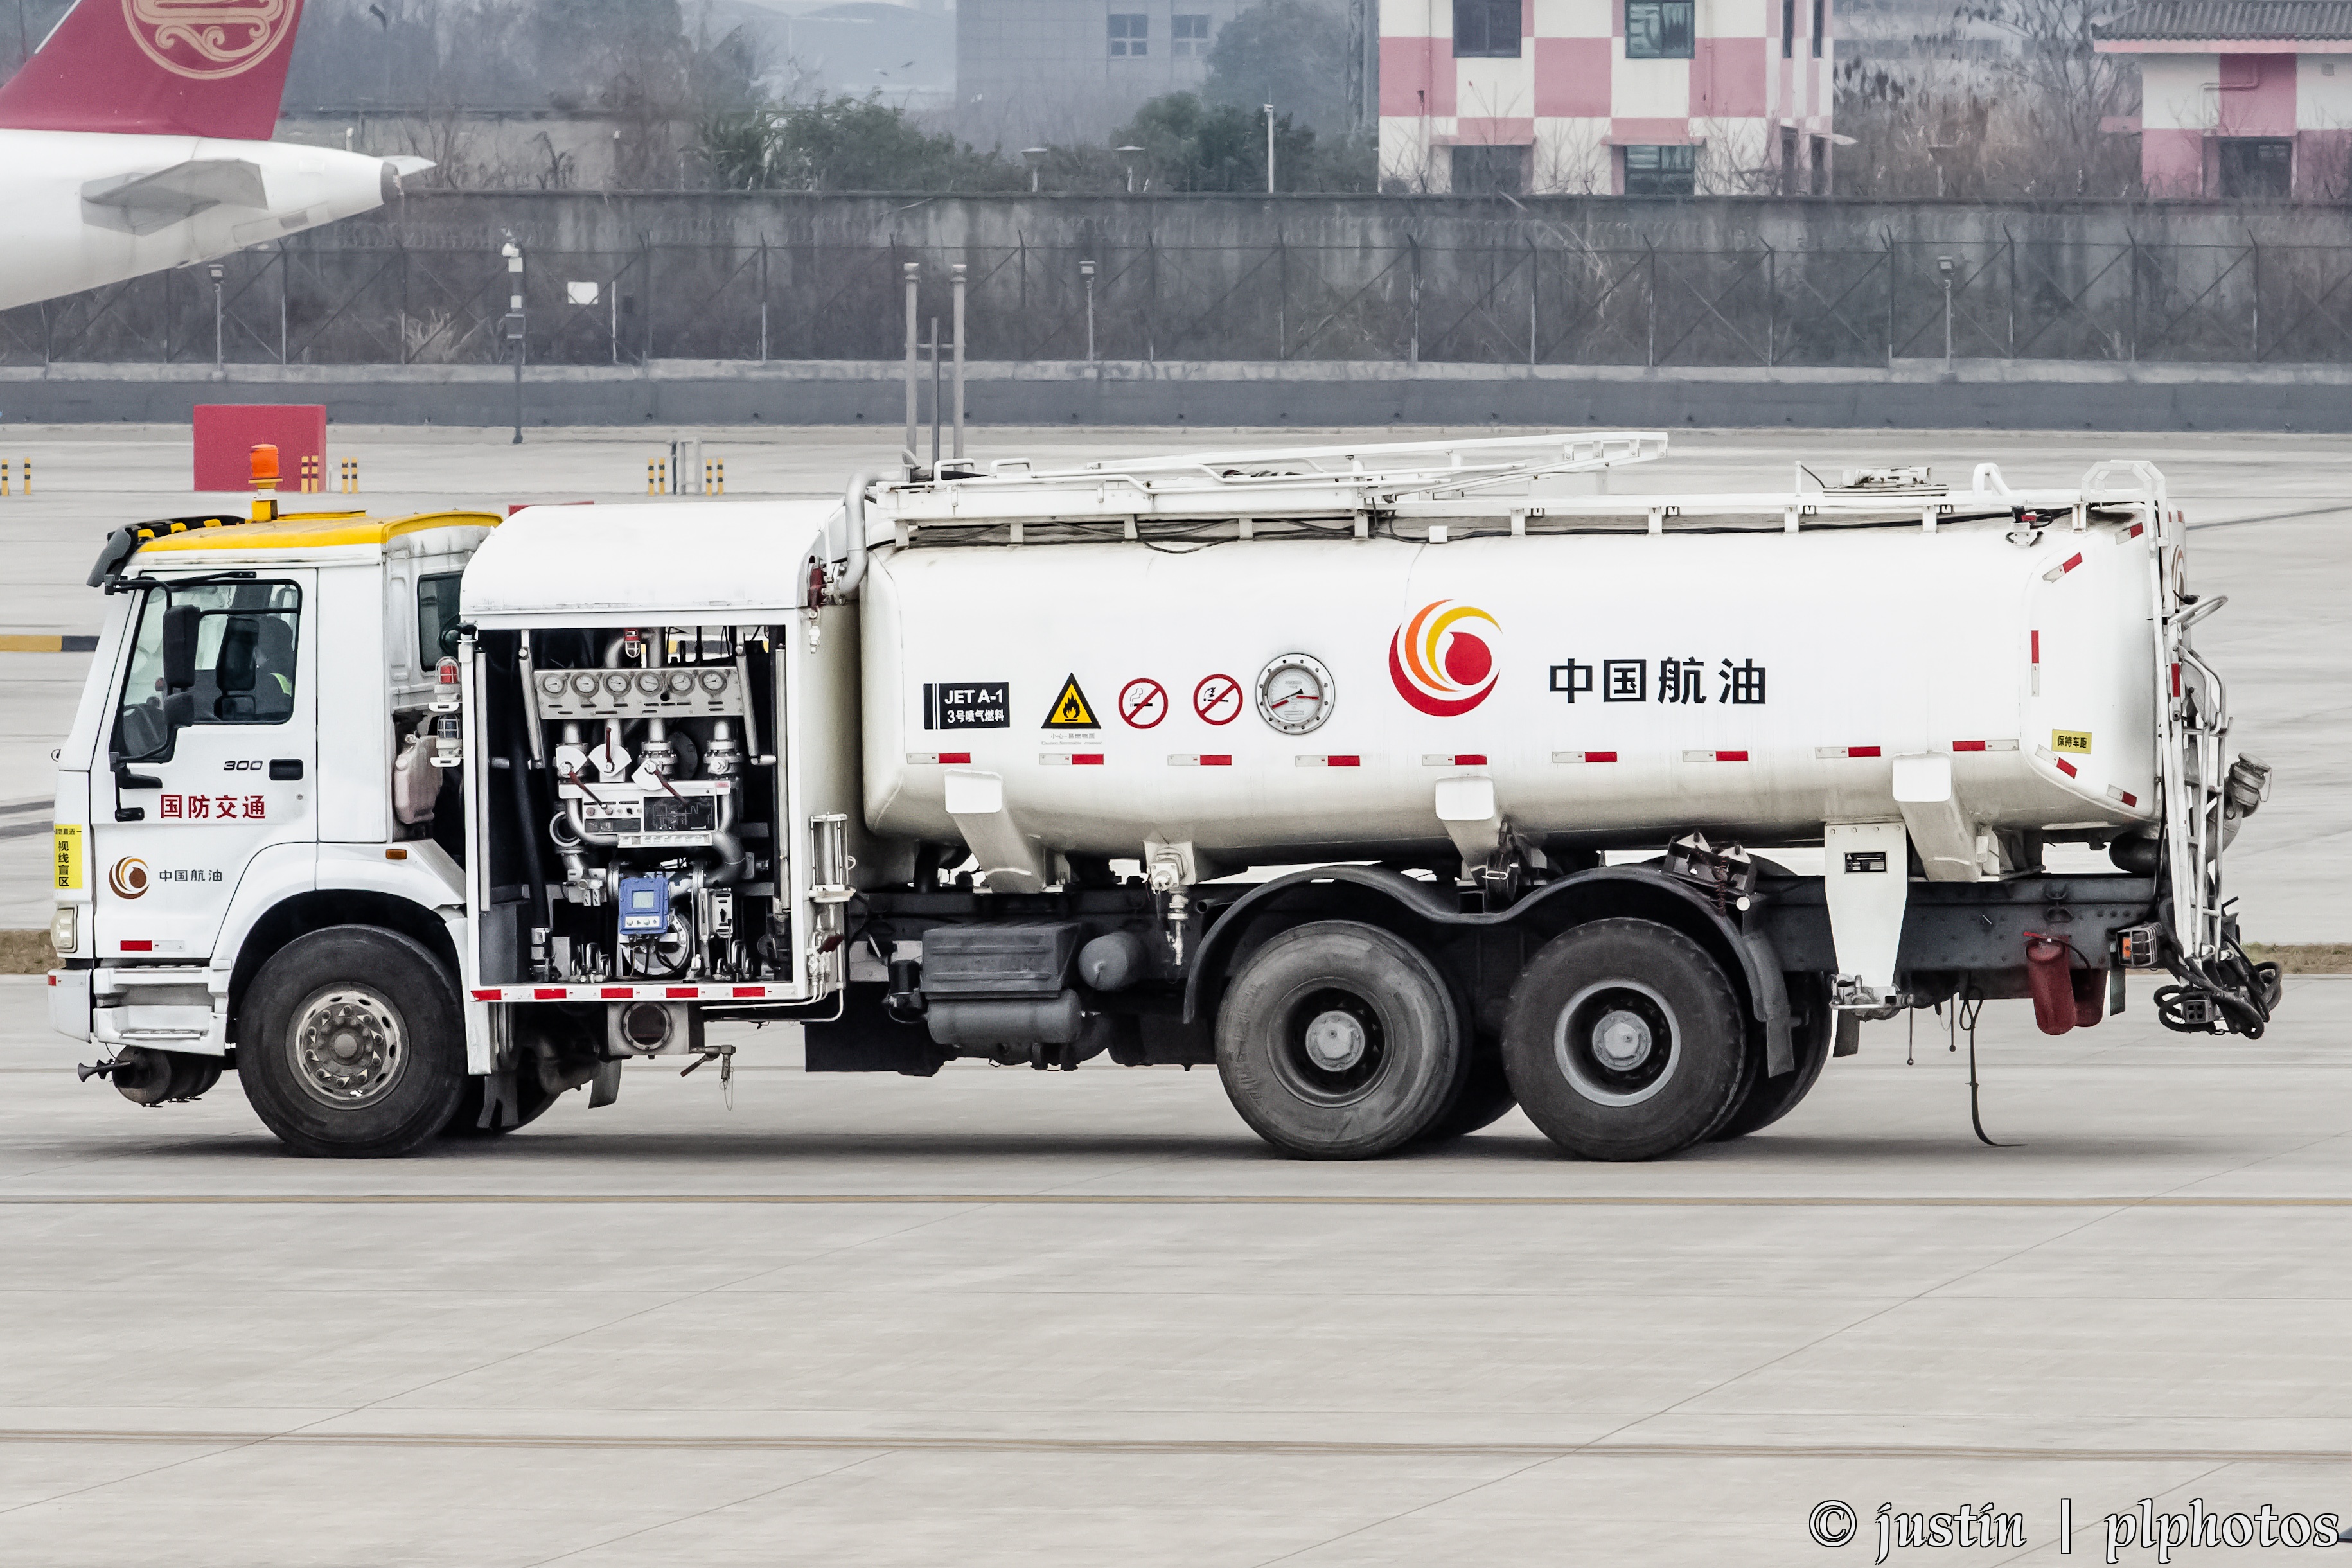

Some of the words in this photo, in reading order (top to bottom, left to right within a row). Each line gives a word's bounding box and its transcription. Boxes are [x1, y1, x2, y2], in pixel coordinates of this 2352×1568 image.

[1550, 656, 1766, 705] 中国航油
[944, 689, 975, 705] JET
[977, 689, 1004, 703] A-1
[947, 709, 1004, 723] 3号喷气燃料
[2057, 735, 2087, 748] 保持车距
[224, 760, 263, 771] 300
[161, 794, 267, 819] 国防交通
[58, 841, 70, 886] 视线盲区
[159, 869, 223, 882] 中国航油
